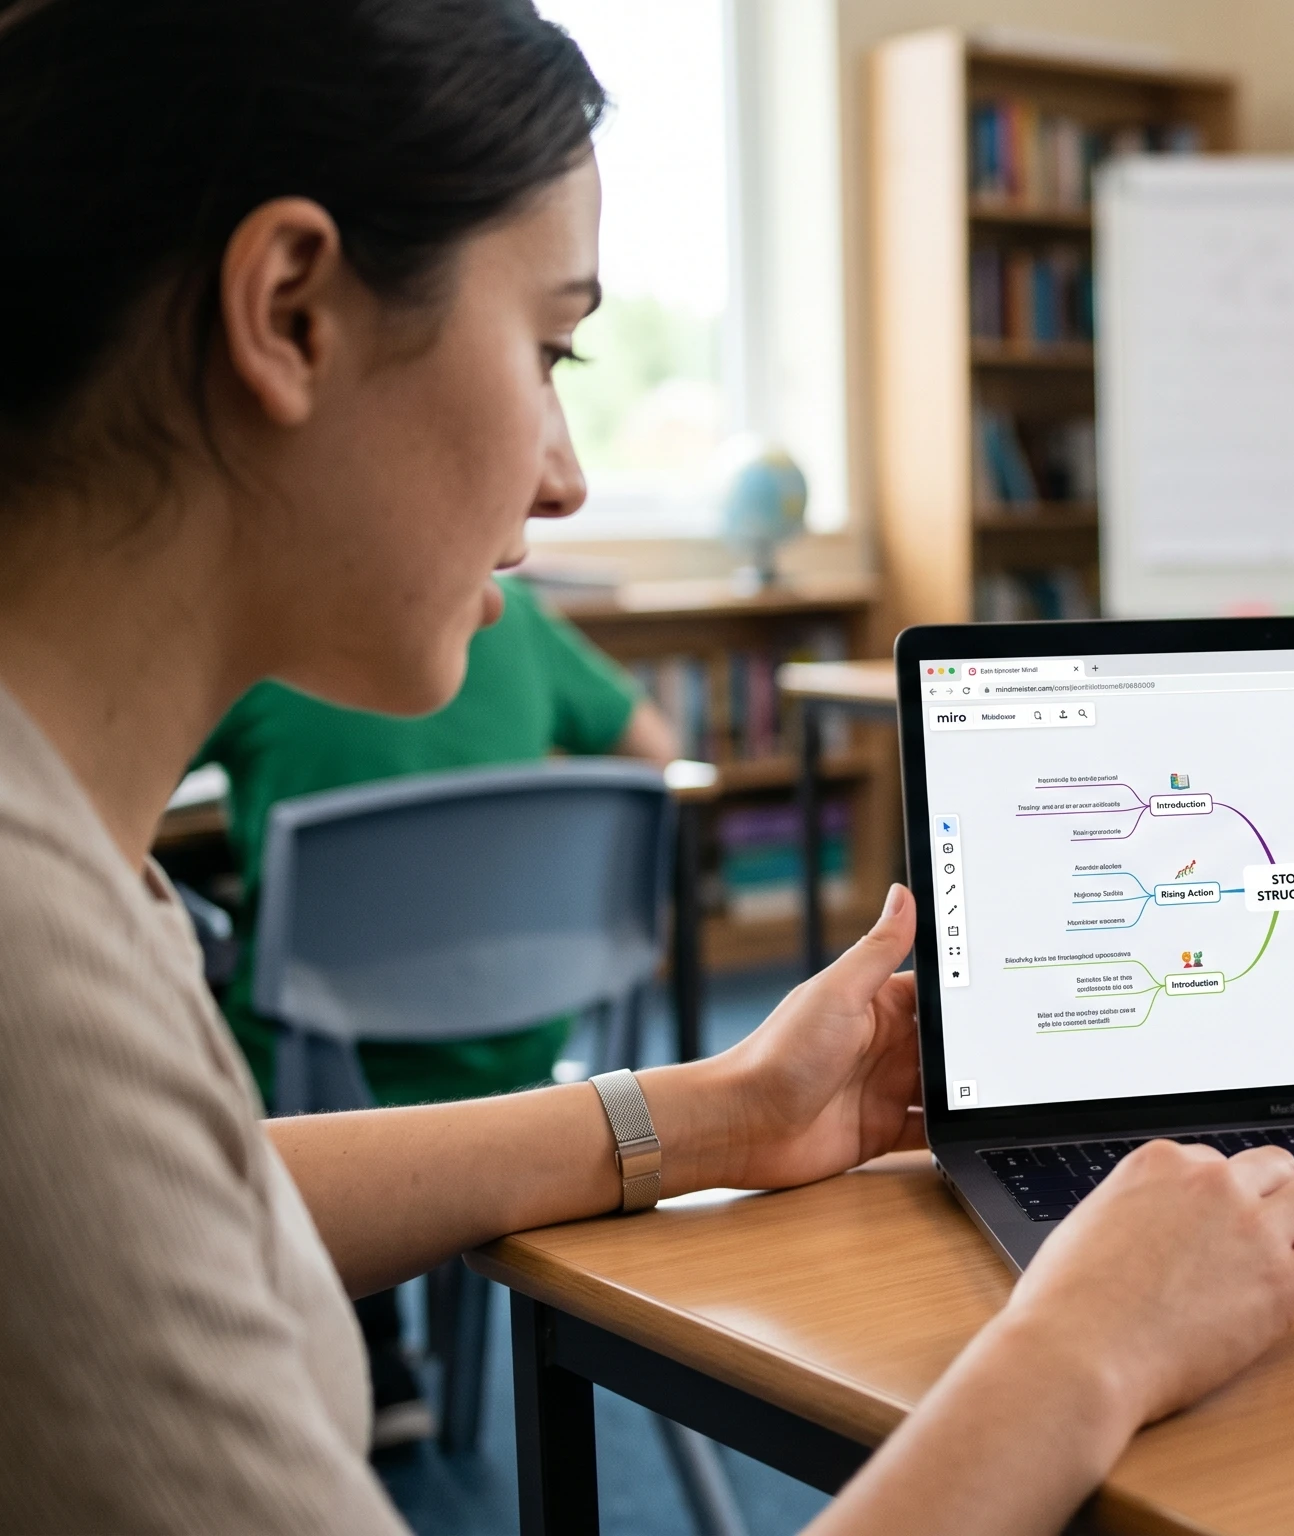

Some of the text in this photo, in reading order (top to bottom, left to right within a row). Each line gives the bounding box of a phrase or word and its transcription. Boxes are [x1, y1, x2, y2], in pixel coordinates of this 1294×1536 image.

[937, 712, 967, 723] miro
[1156, 800, 1206, 810] Introduction
[1161, 889, 1214, 899] Rising Action
[1171, 979, 1219, 989] Introduction
